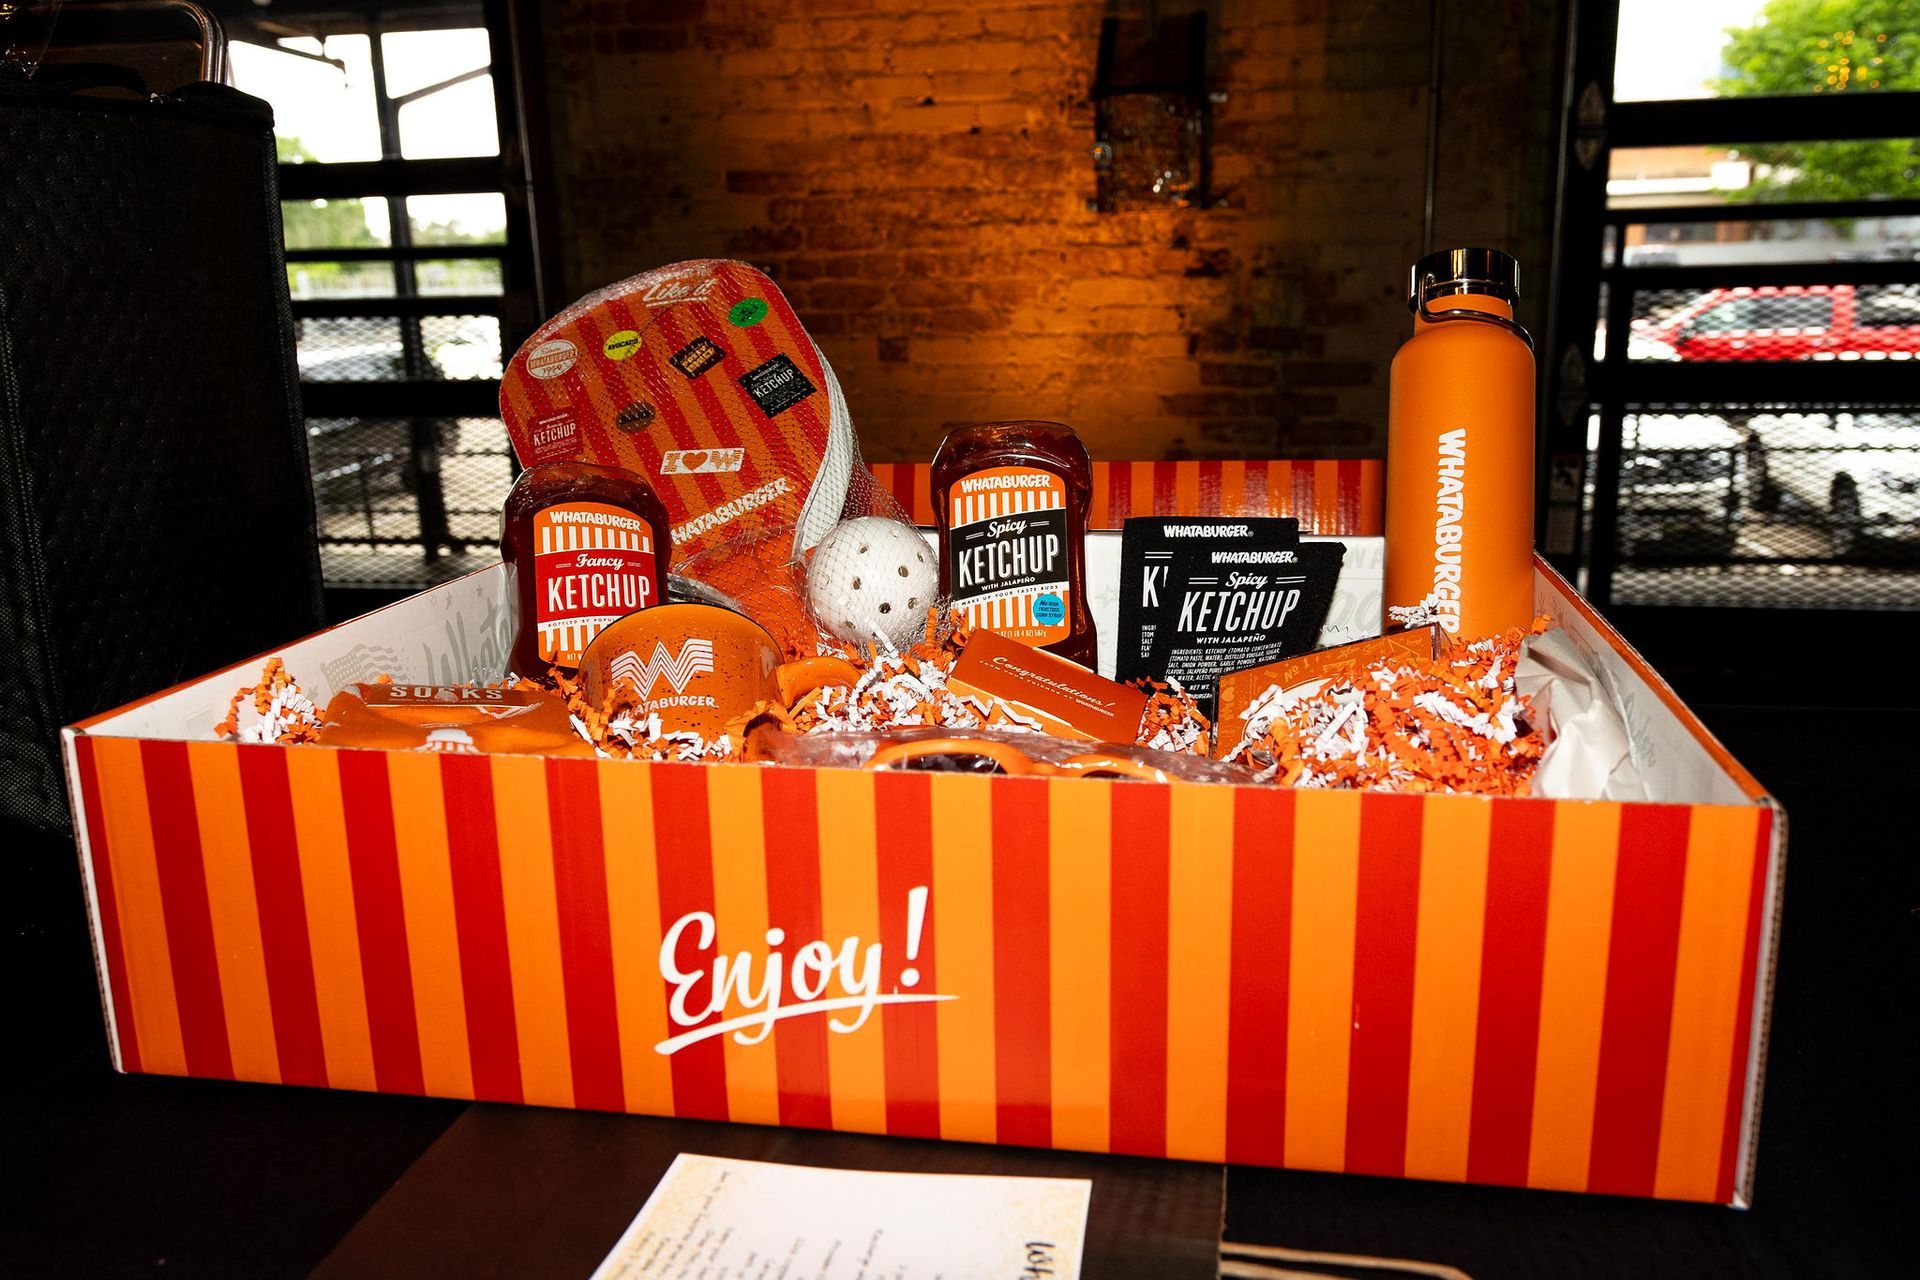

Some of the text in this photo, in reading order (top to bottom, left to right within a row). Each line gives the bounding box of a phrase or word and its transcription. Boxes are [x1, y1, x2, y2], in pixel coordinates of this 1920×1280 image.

[753, 368, 795, 398] KETCHUP
[533, 422, 576, 446] KETCHUP
[961, 474, 1051, 494] WHATABURGER
[549, 511, 641, 531] WHATABURGER
[670, 477, 792, 545] HATABURGER
[986, 519, 1028, 538] Spicy
[575, 553, 625, 571] Fancy
[958, 534, 1060, 588] KETCHUP
[981, 576, 1036, 592] WITH JALAPEÑO
[1225, 571, 1268, 589] Spicy
[548, 573, 651, 613] KETCHUP
[1177, 589, 1301, 633] KETCHUP
[548, 620, 578, 628] BOTTLED
[1196, 633, 1267, 645] WITH JALAPEÑO
[993, 657, 1116, 708] Congratulations!
[617, 695, 720, 720] ATABURGER
[656, 885, 930, 1048] Enjoy!
